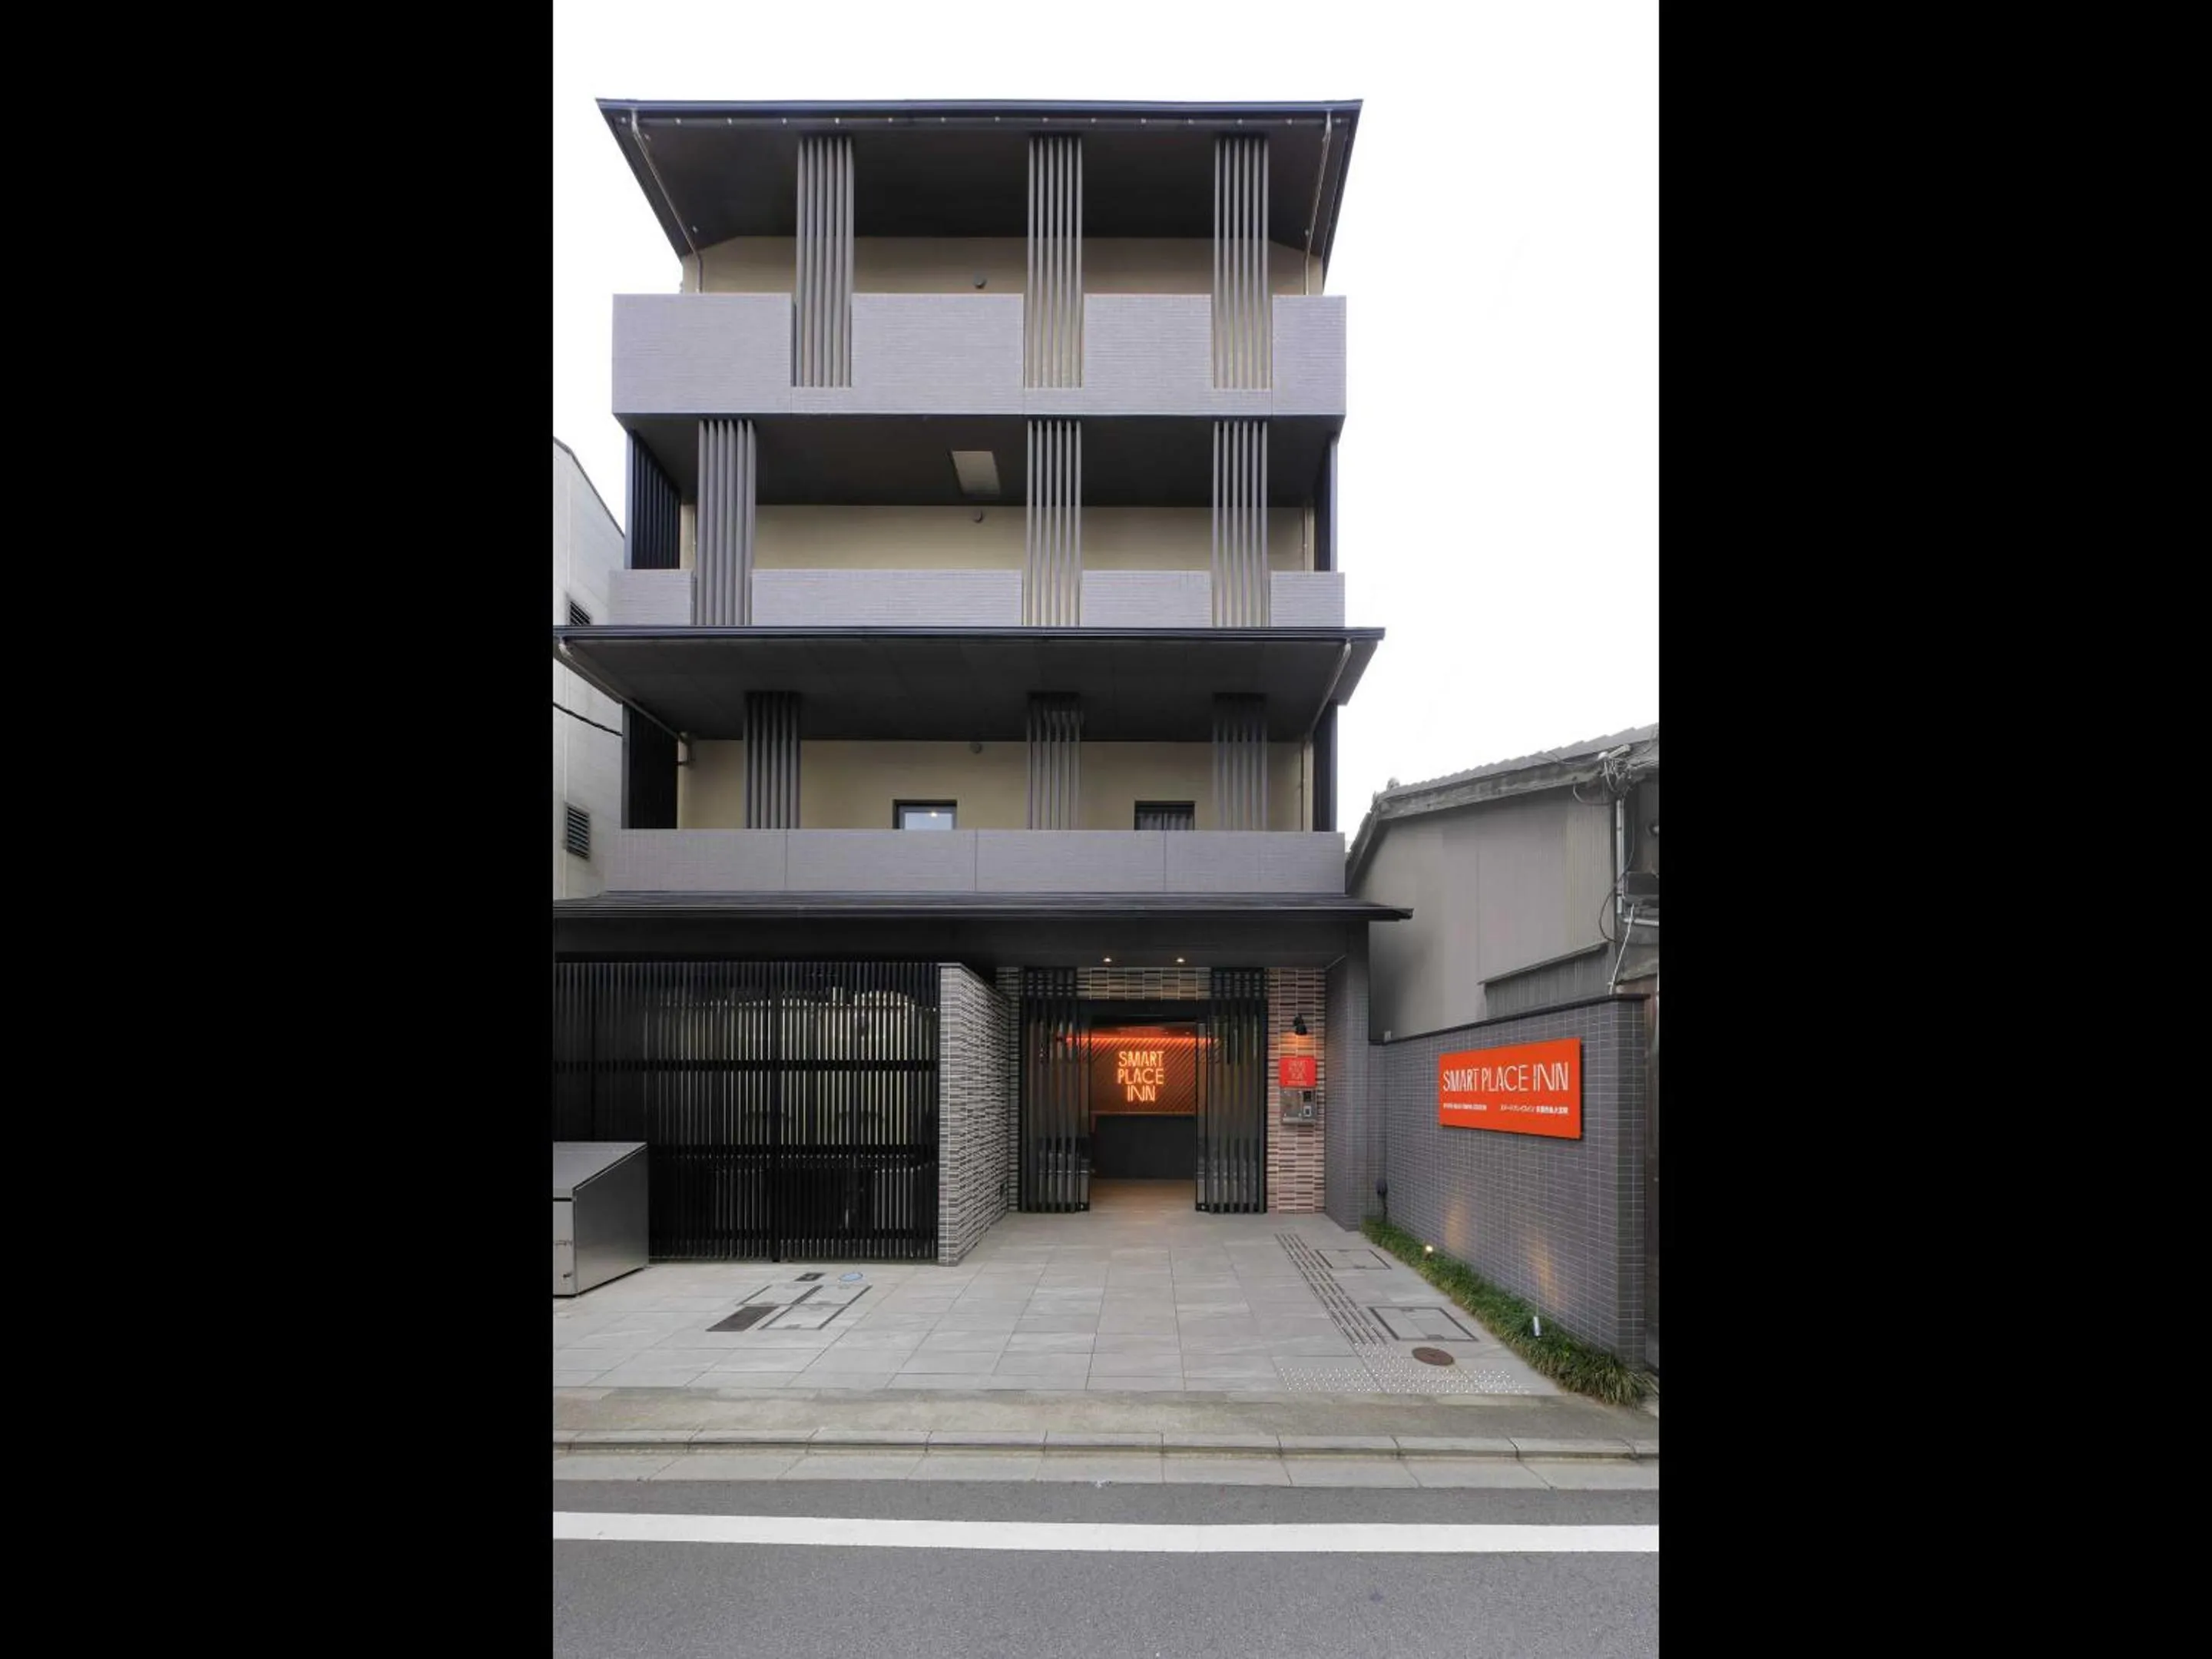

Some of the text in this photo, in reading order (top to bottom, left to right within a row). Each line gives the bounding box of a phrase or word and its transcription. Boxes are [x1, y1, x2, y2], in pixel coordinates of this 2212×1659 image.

[1118, 1051, 1164, 1067] SMART
[1117, 1068, 1164, 1084] PLACE
[1443, 1061, 1568, 1092] SMART PLACE INN
[1127, 1084, 1156, 1102] INN
